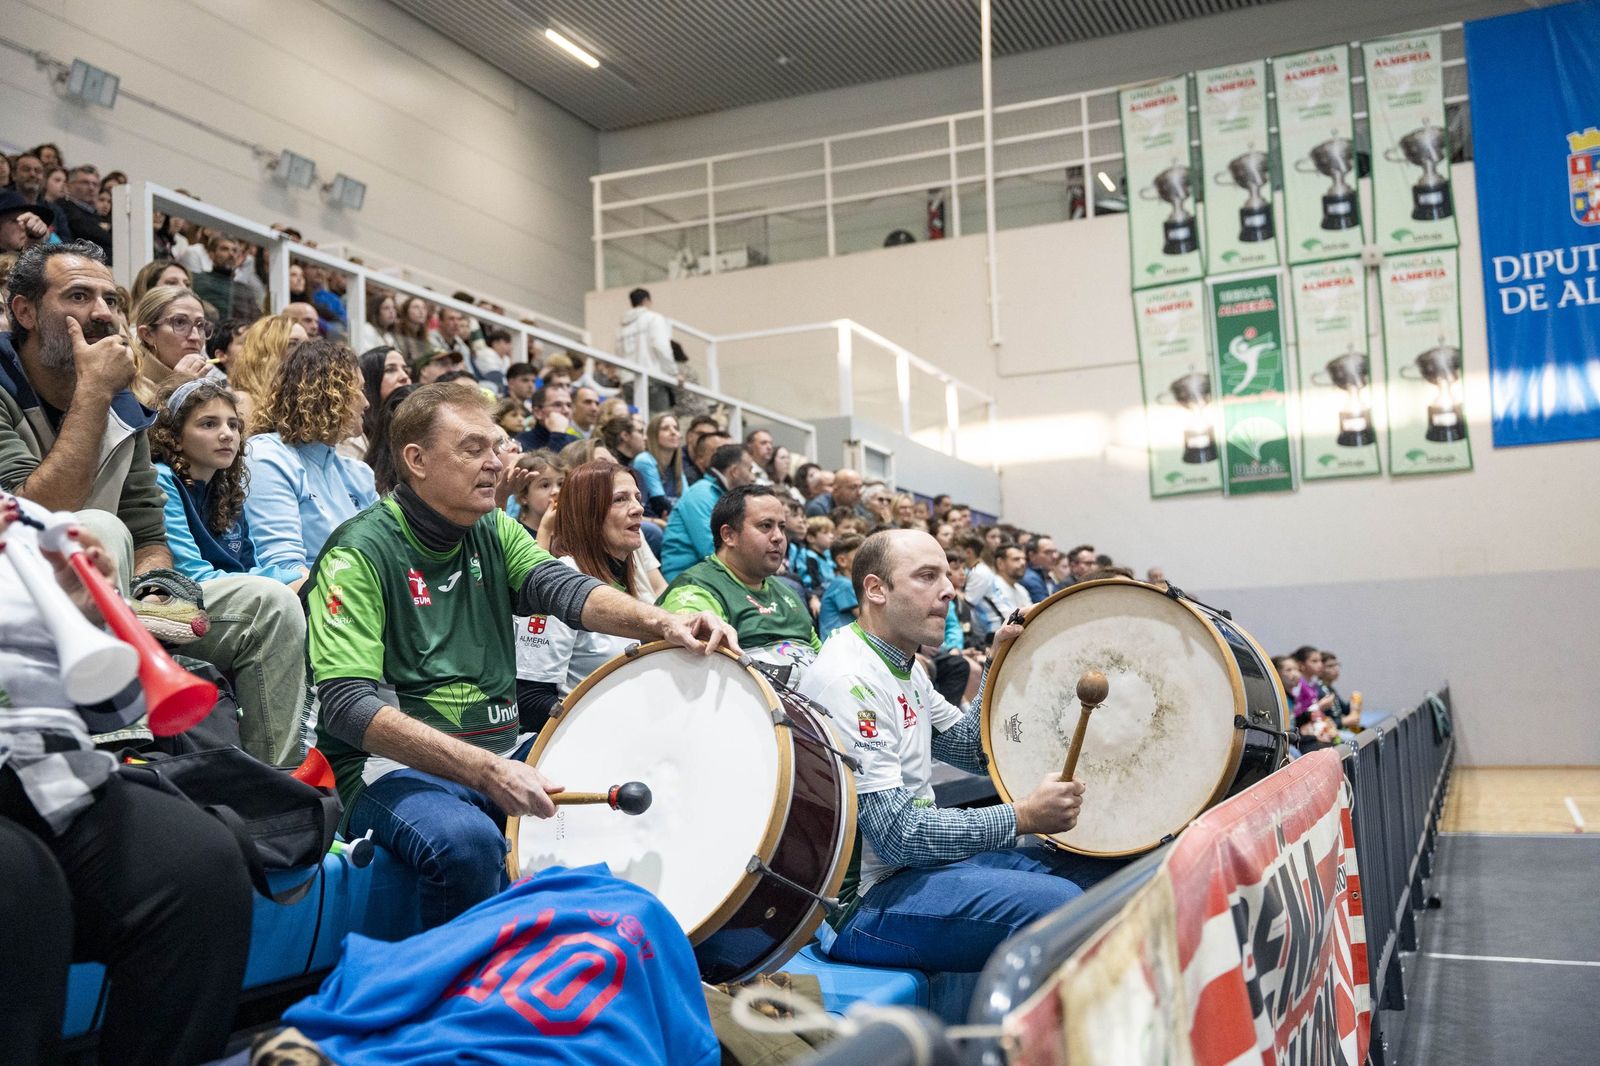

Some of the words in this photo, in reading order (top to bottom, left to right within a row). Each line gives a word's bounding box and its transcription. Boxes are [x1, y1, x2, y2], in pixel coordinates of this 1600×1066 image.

[1492, 243, 1600, 284] DIPUT
[1499, 283, 1549, 315] DE
[1557, 277, 1600, 308] AL
